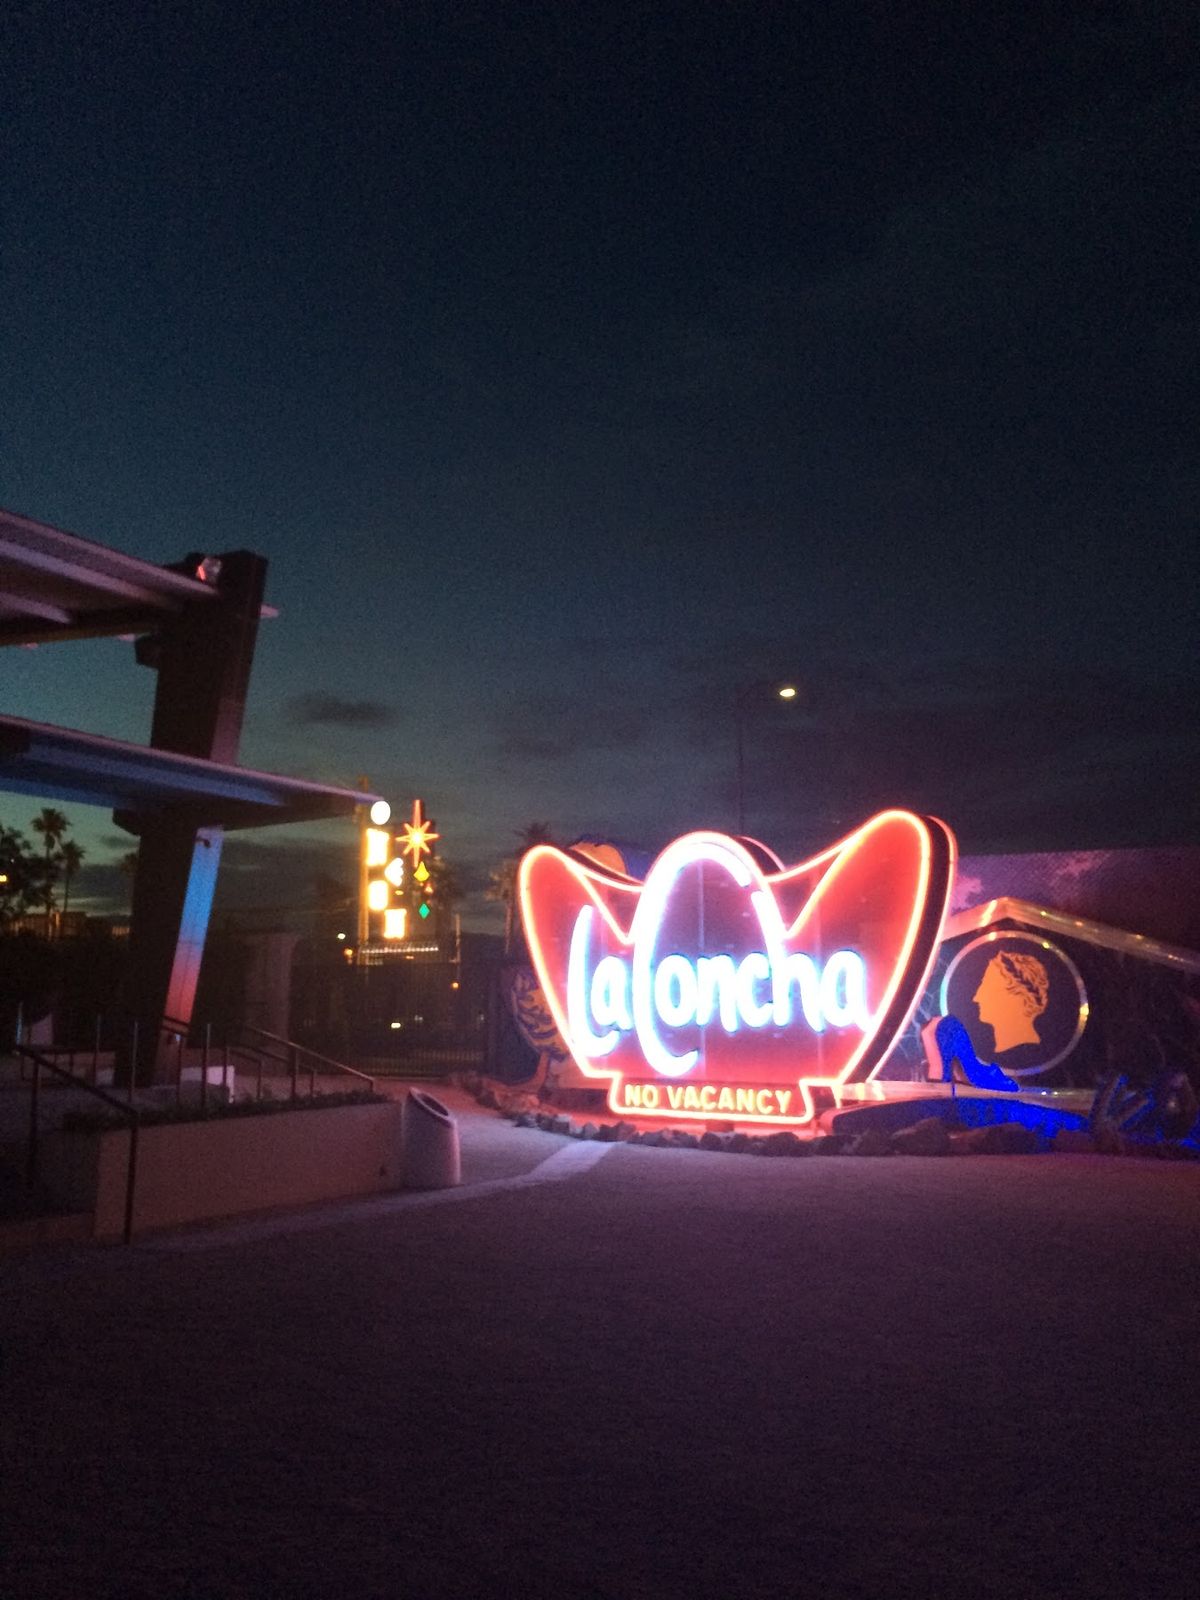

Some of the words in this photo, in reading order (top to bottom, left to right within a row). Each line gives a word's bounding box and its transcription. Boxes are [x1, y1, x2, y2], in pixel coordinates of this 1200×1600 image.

[566, 904, 635, 1058] La
[632, 840, 874, 1077] Concha
[624, 1084, 659, 1108] NO
[667, 1085, 792, 1114] VACANCY
